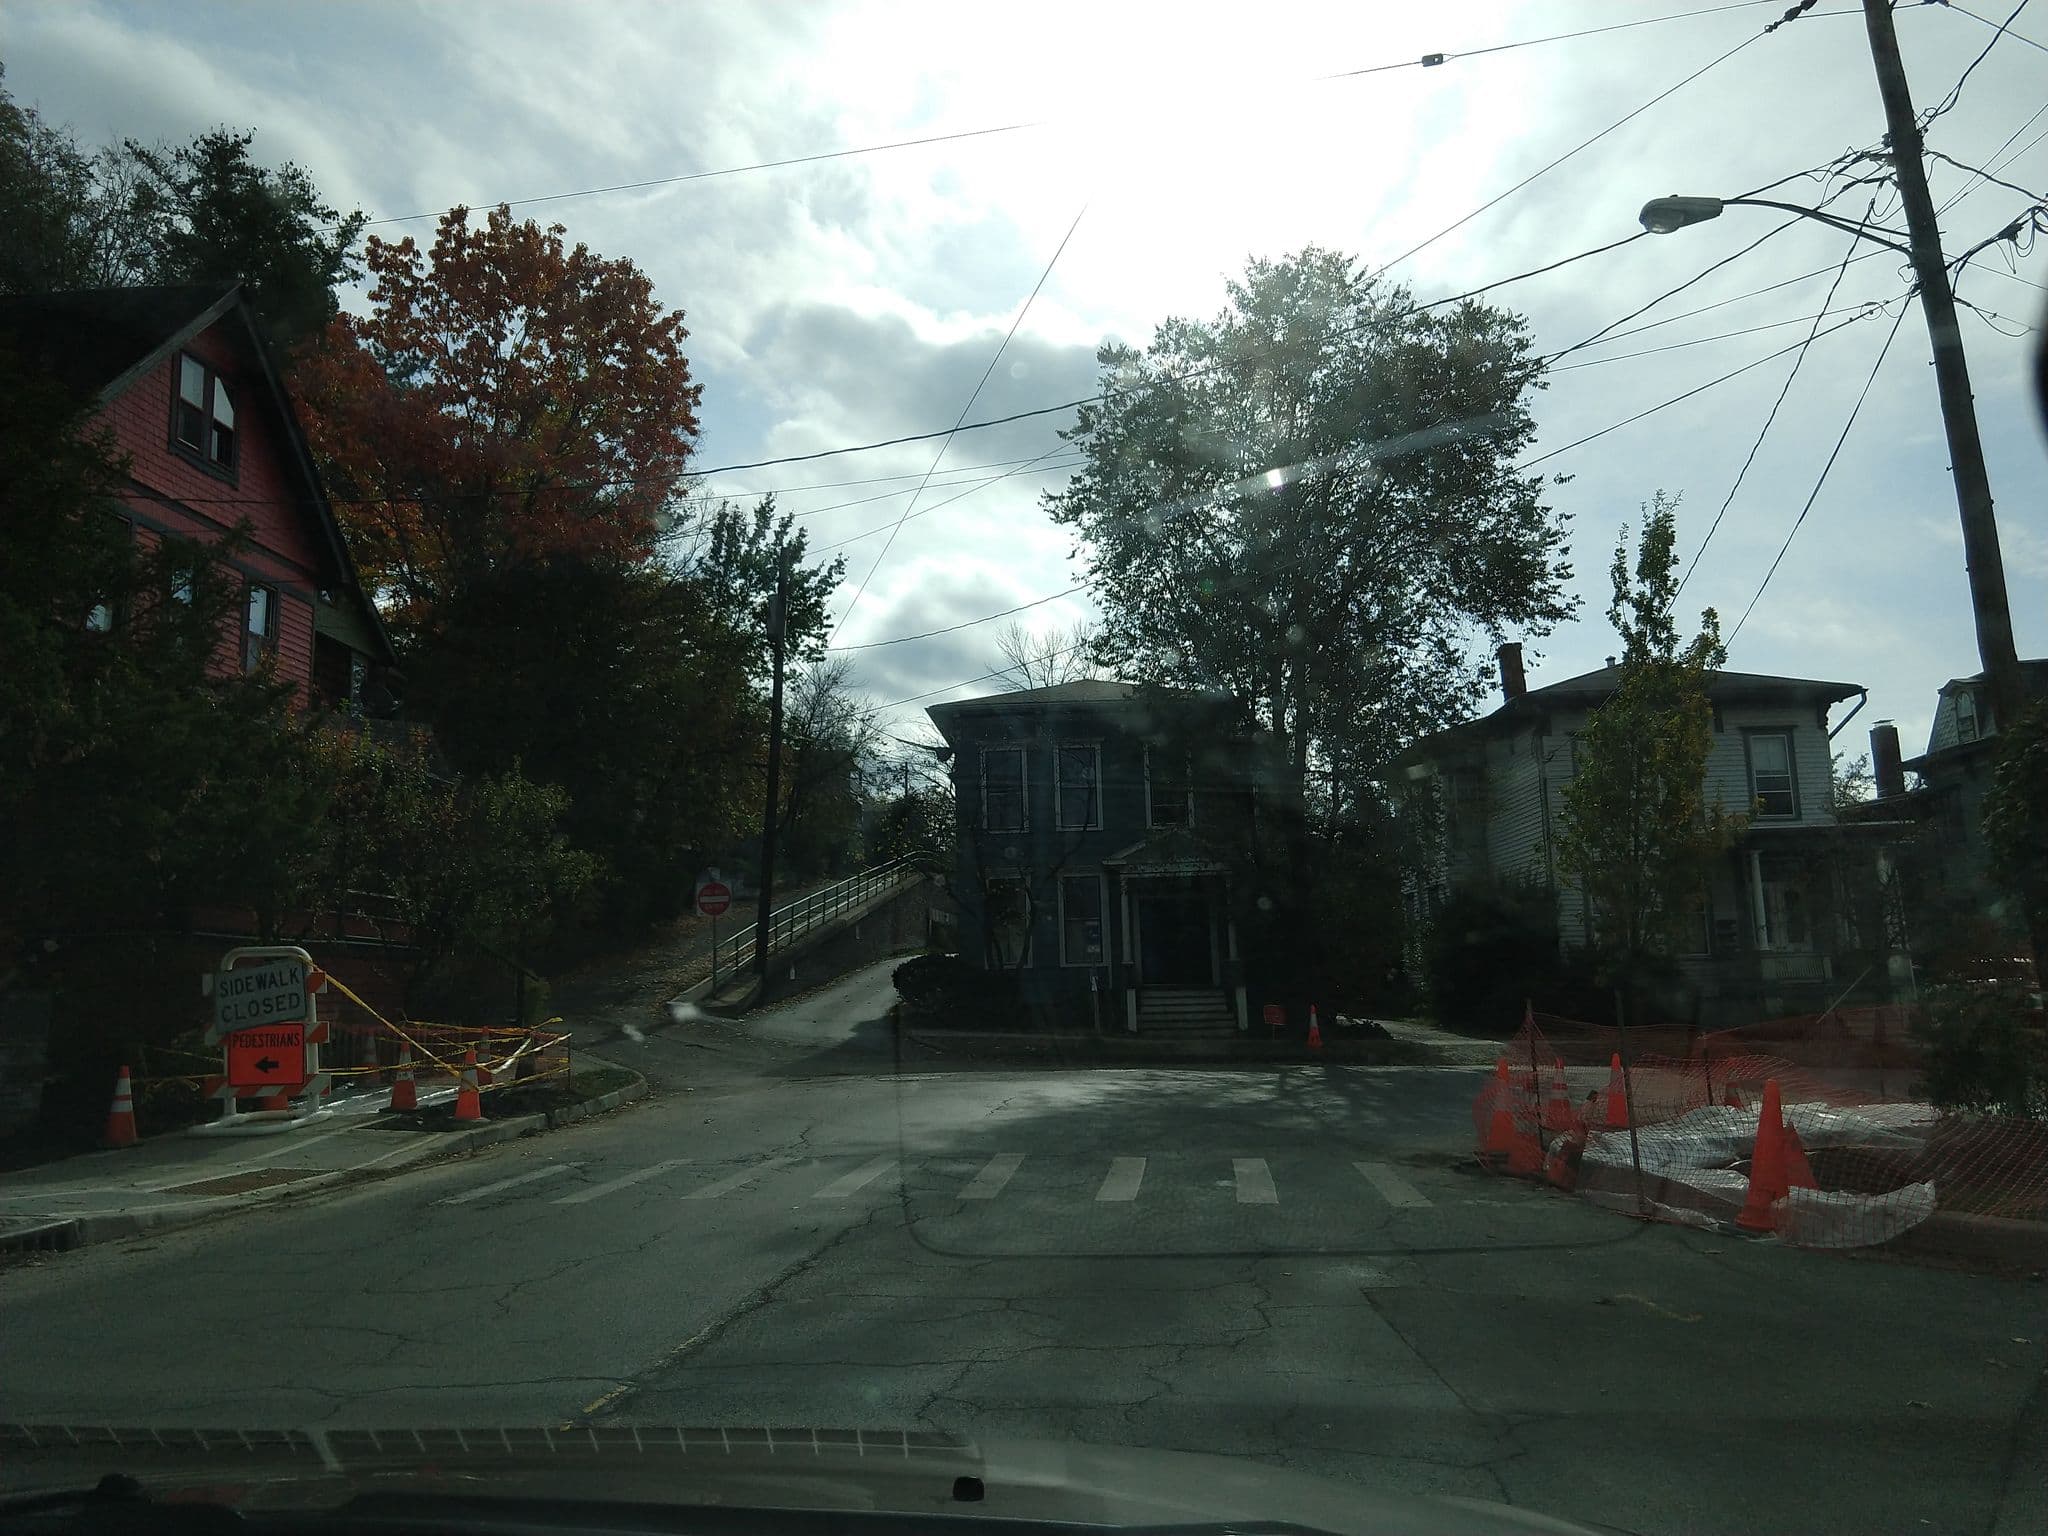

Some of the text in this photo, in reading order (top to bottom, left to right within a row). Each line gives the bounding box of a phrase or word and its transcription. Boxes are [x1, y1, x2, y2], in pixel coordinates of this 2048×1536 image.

[220, 967, 299, 998] SIDEWALK
[221, 993, 300, 1023] CLOSED
[232, 1033, 300, 1048] PEDESTRIANS
